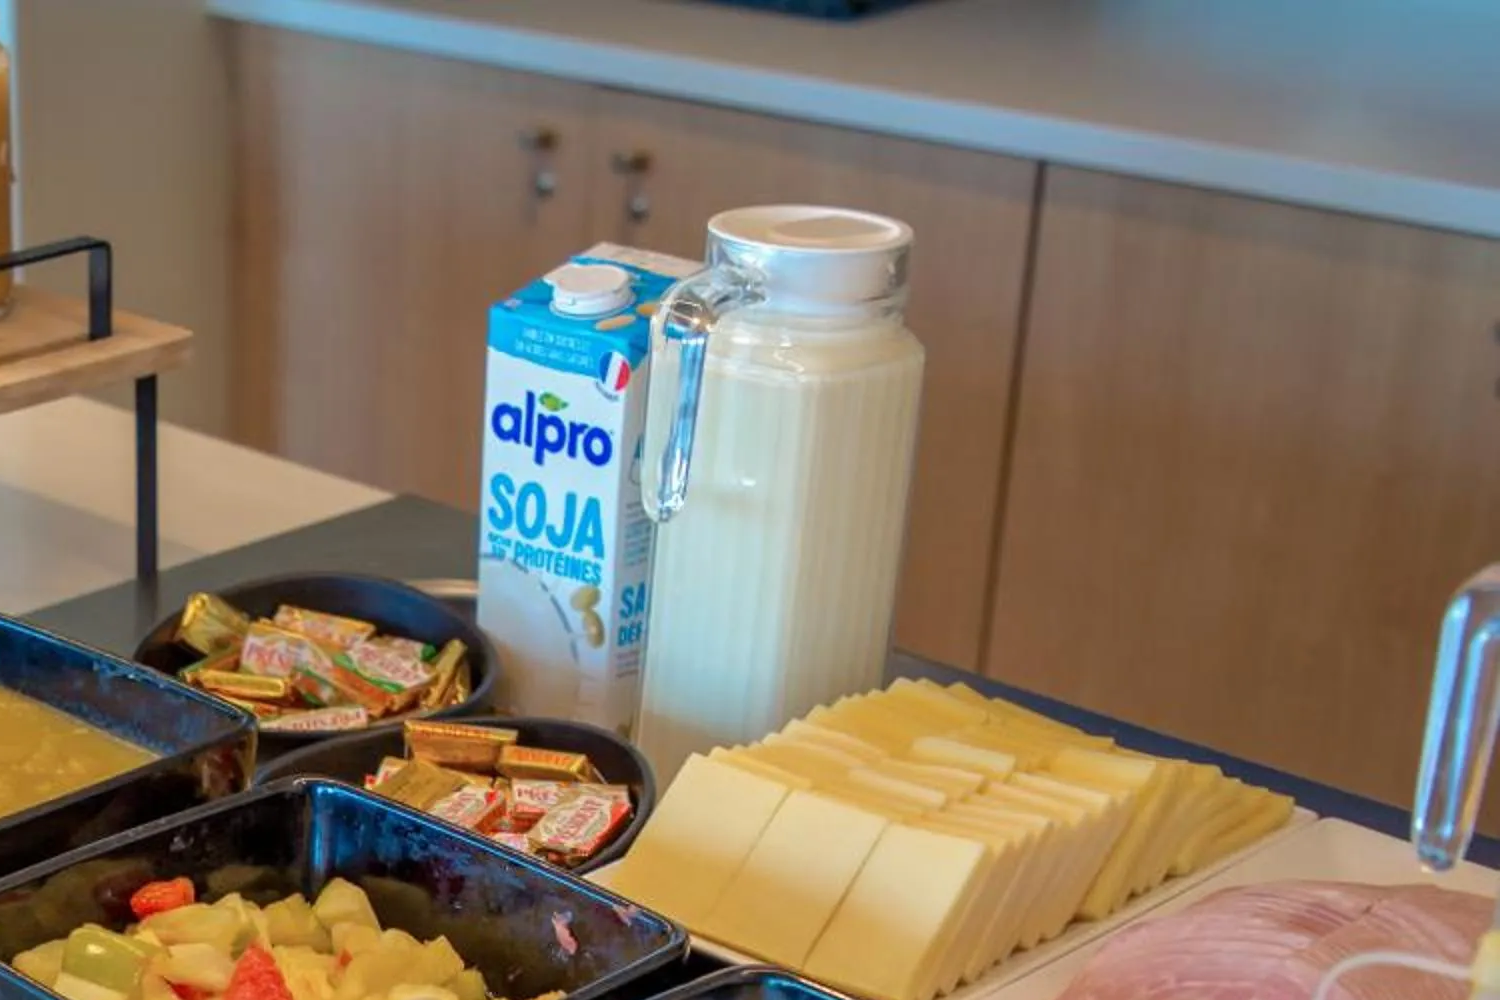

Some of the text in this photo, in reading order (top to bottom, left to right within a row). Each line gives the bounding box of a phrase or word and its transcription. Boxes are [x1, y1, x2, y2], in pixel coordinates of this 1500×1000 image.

[491, 390, 613, 466] alpro
[488, 472, 605, 560] SOJA
[513, 541, 603, 586] PROTÉINES
